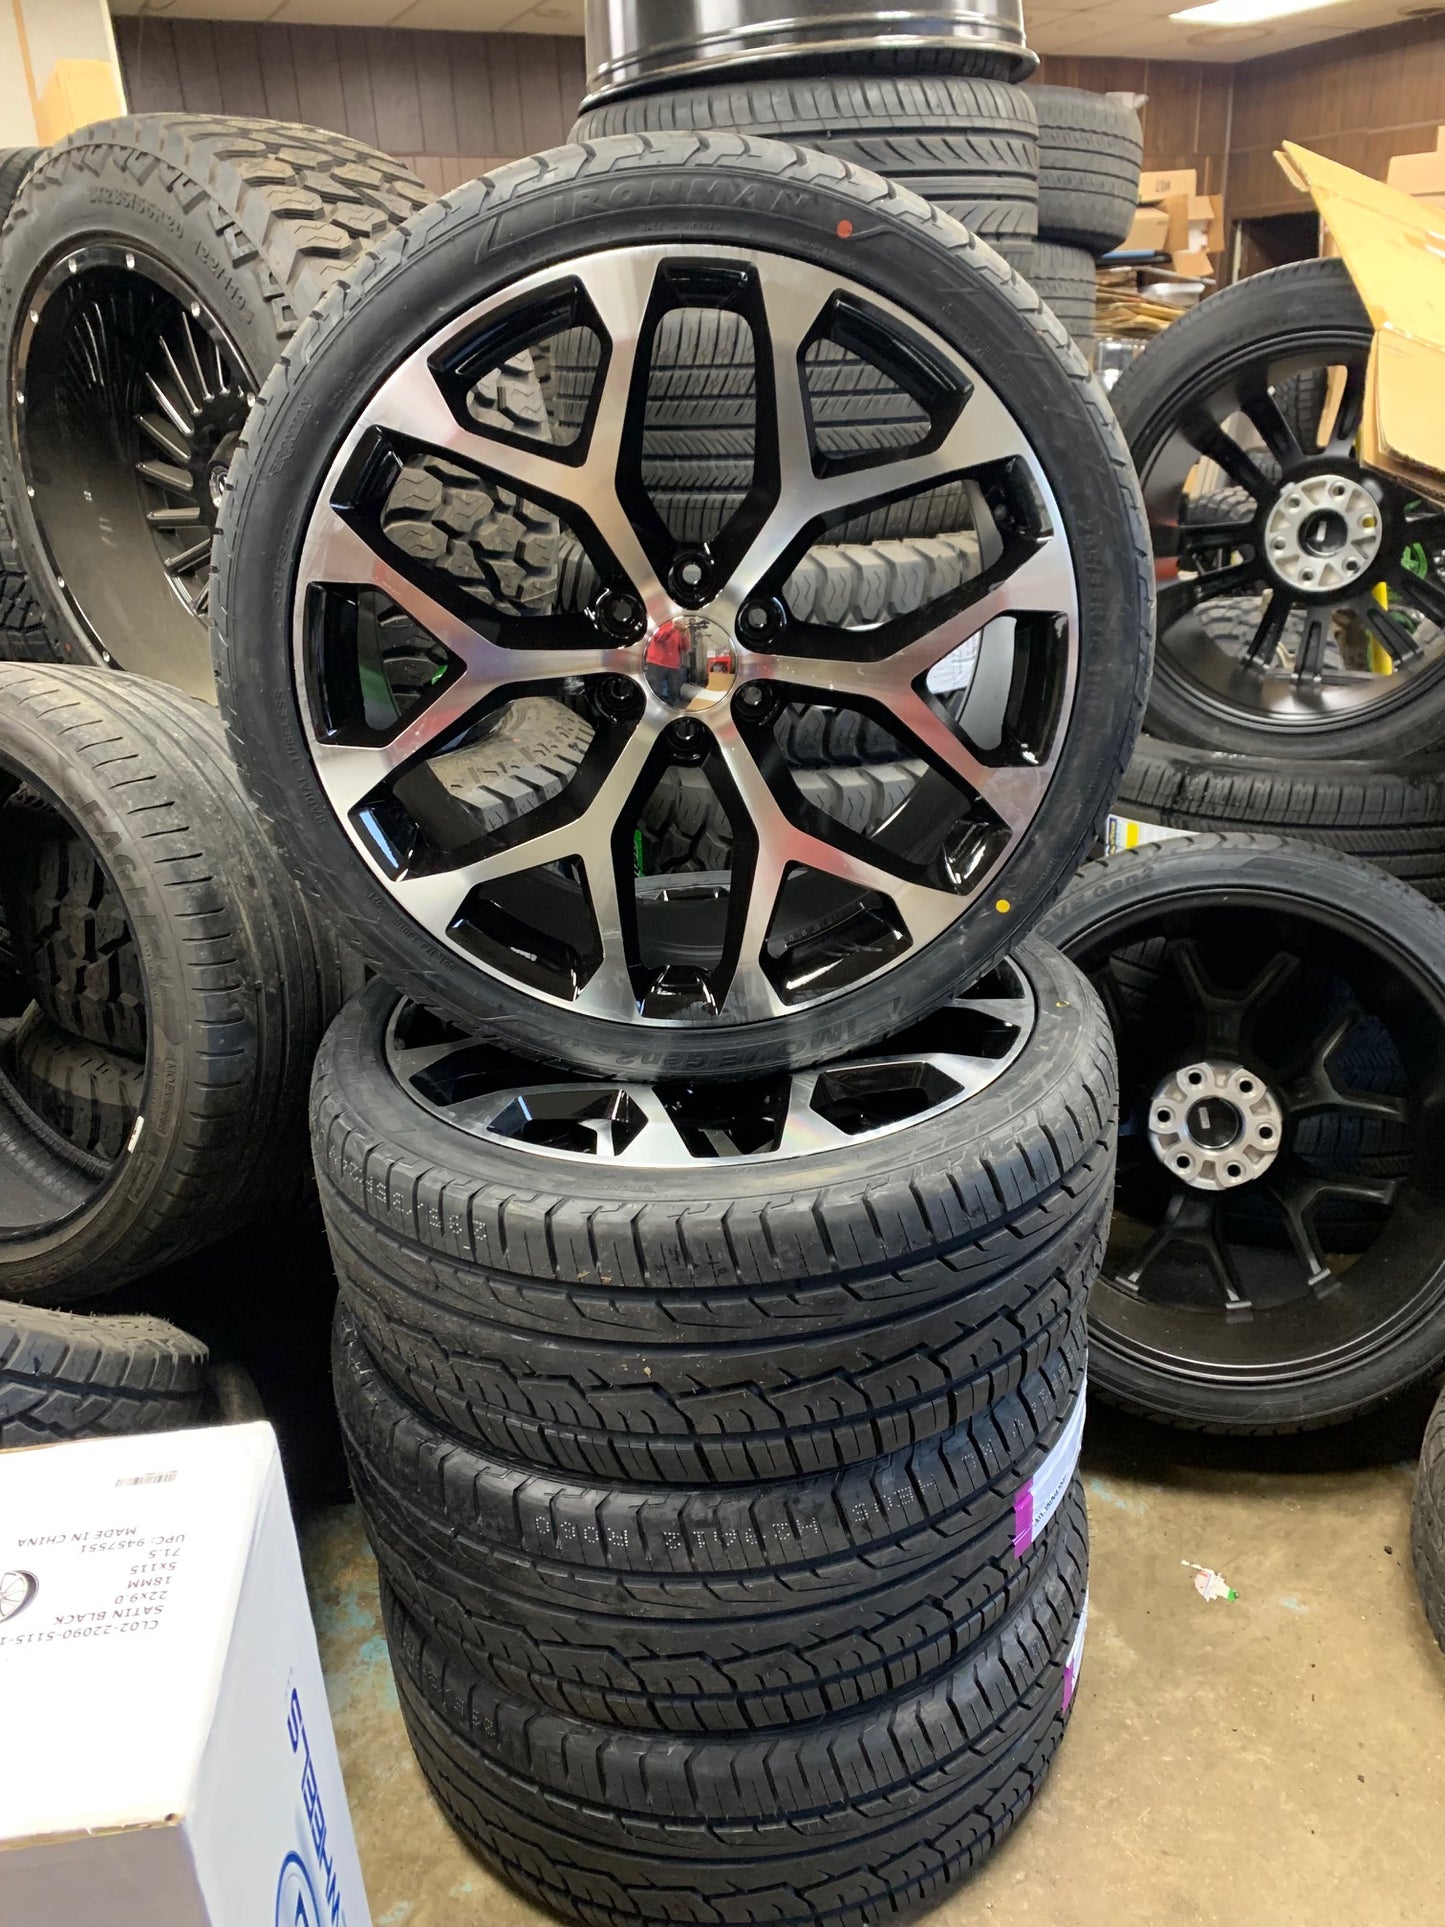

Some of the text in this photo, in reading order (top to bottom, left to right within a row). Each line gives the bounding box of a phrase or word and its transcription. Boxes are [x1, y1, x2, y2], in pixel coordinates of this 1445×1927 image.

[552, 176, 811, 224] IRONMAN
[18, 1526, 137, 1547] MADE IN CHINA
[149, 1547, 180, 1559] 71.5
[131, 1561, 177, 1575] 5x115
[127, 1575, 171, 1589] 18MM
[115, 1590, 167, 1605] 22x9.0
[53, 1604, 164, 1625] SATIN BLACK
[286, 1686, 341, 1927] WHEELS
